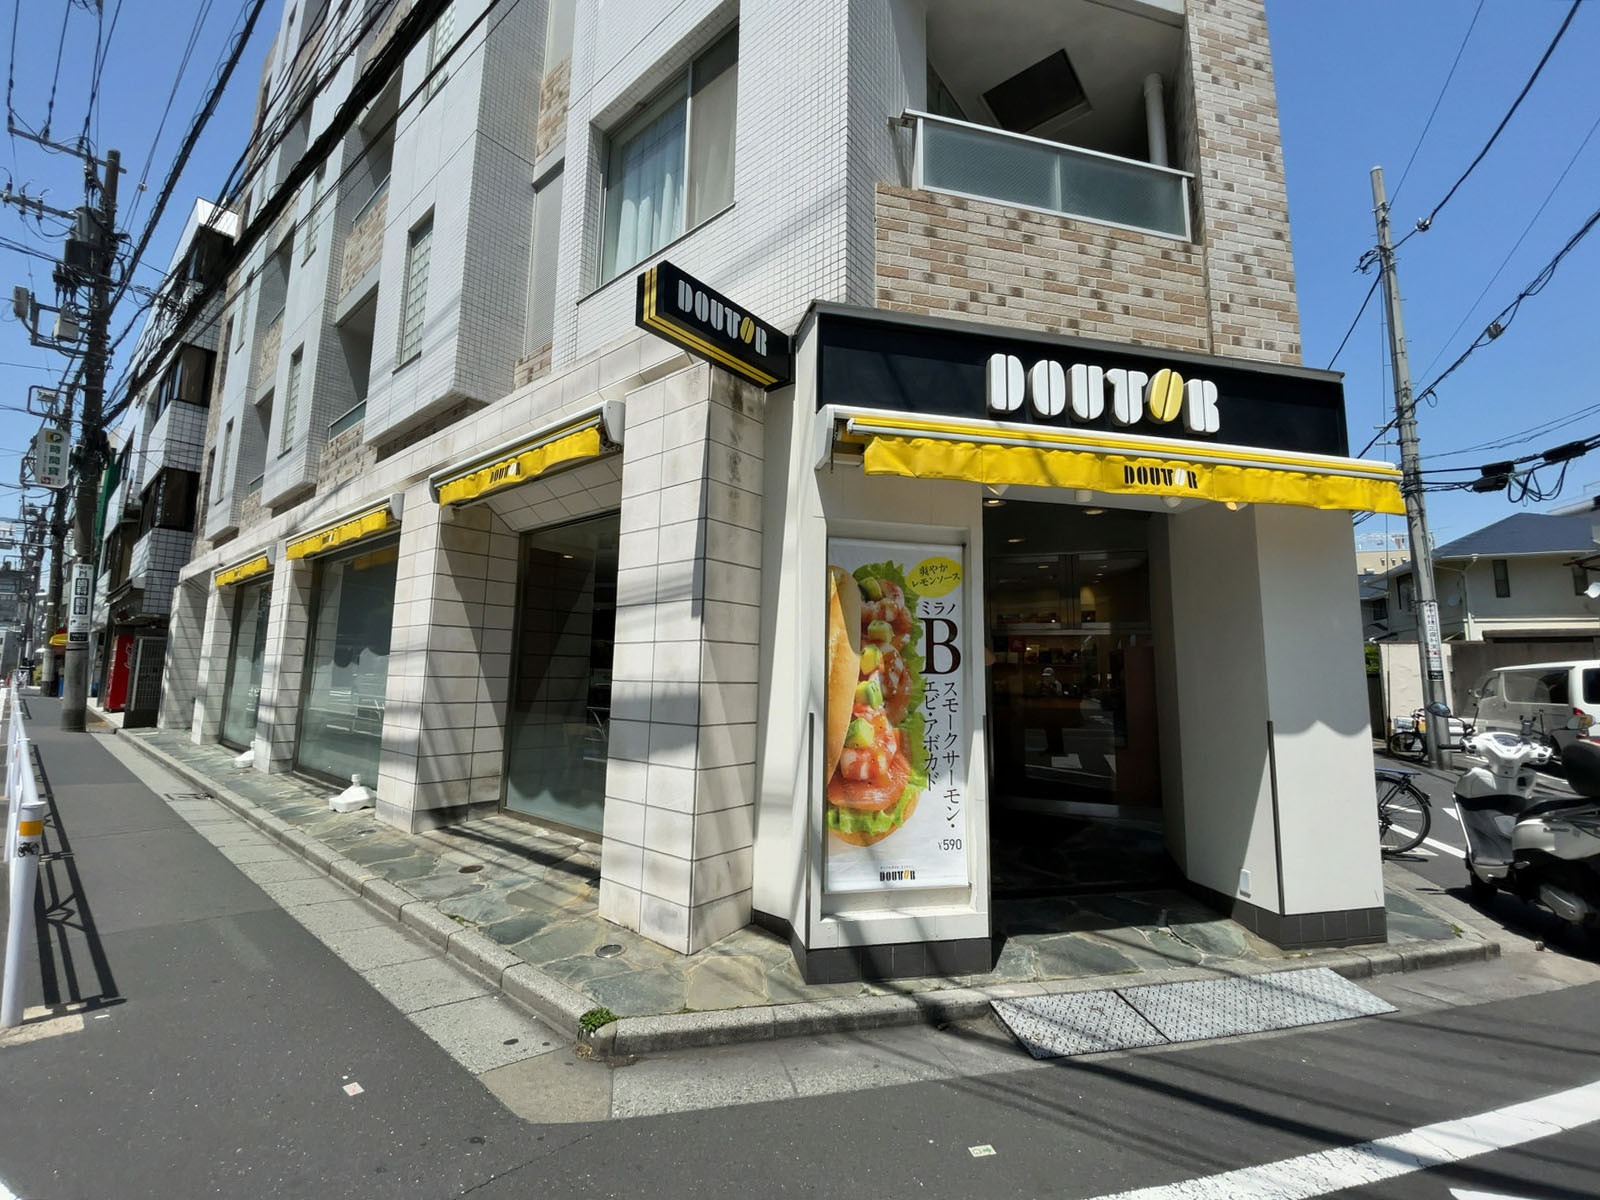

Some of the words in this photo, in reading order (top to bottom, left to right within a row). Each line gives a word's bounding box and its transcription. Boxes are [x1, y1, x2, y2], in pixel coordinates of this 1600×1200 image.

[678, 279, 767, 357] DOUTOR
[987, 353, 1221, 434] DOUTOR
[1124, 465, 1198, 490] DOUTOR
[911, 572, 960, 588] レモンソース
[919, 563, 948, 577] 爽やか
[921, 601, 956, 616] ミラノ
[918, 617, 961, 675] B
[923, 681, 940, 792] エビ・アボカド
[938, 838, 962, 851] ¥590
[879, 869, 916, 882] DOUTOR
